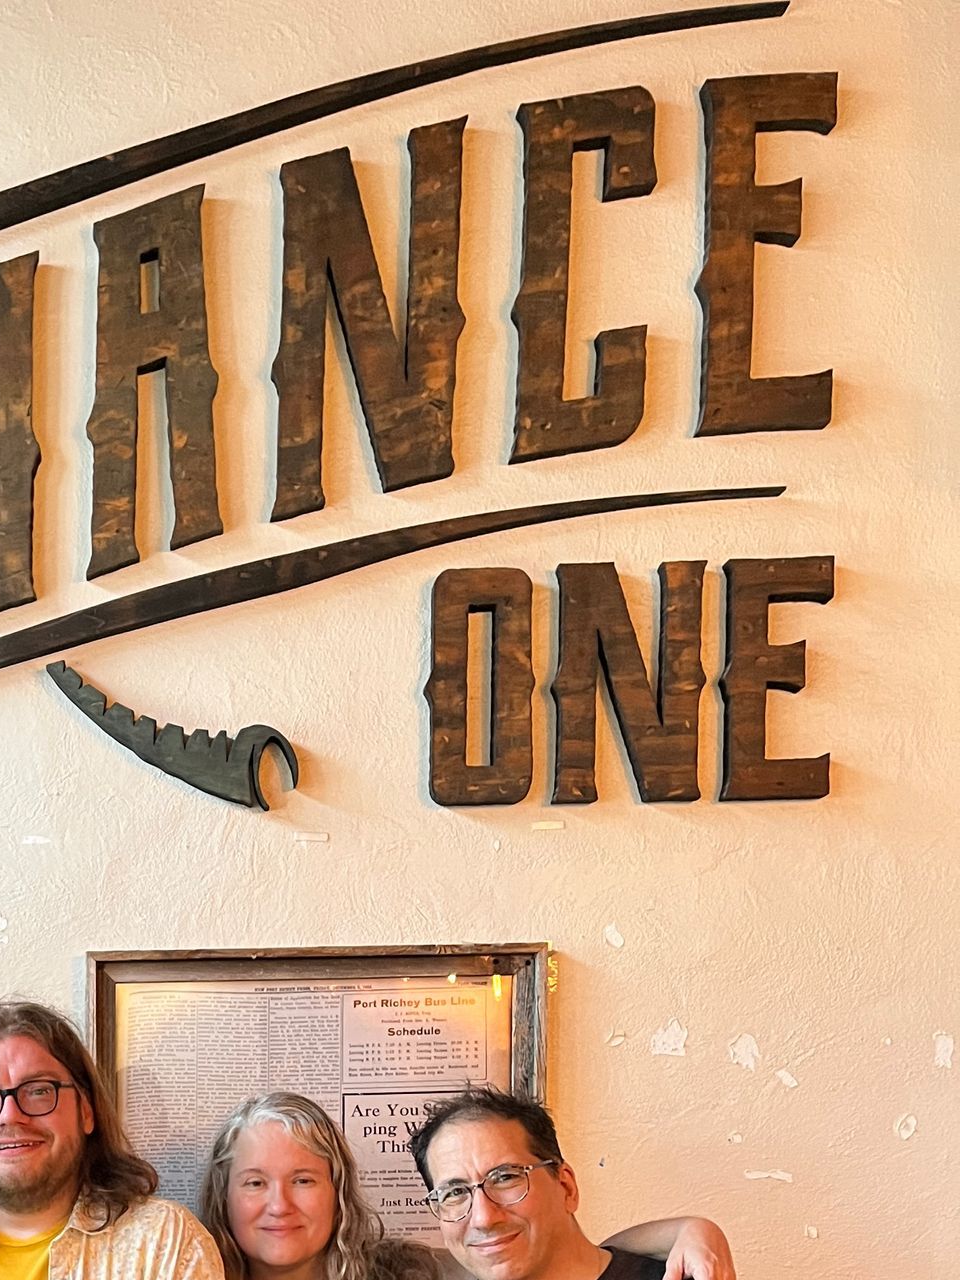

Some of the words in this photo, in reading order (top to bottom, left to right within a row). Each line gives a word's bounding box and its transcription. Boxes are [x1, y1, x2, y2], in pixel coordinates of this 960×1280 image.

[425, 556, 835, 806] ONE
[353, 999, 377, 1009] Port
[381, 997, 421, 1009] Richey
[424, 997, 447, 1007] Bus
[450, 996, 477, 1006] Line
[387, 1026, 441, 1037] Schedule
[351, 1104, 380, 1118] Are
[387, 1103, 419, 1117] You
[363, 1122, 398, 1138] ping
